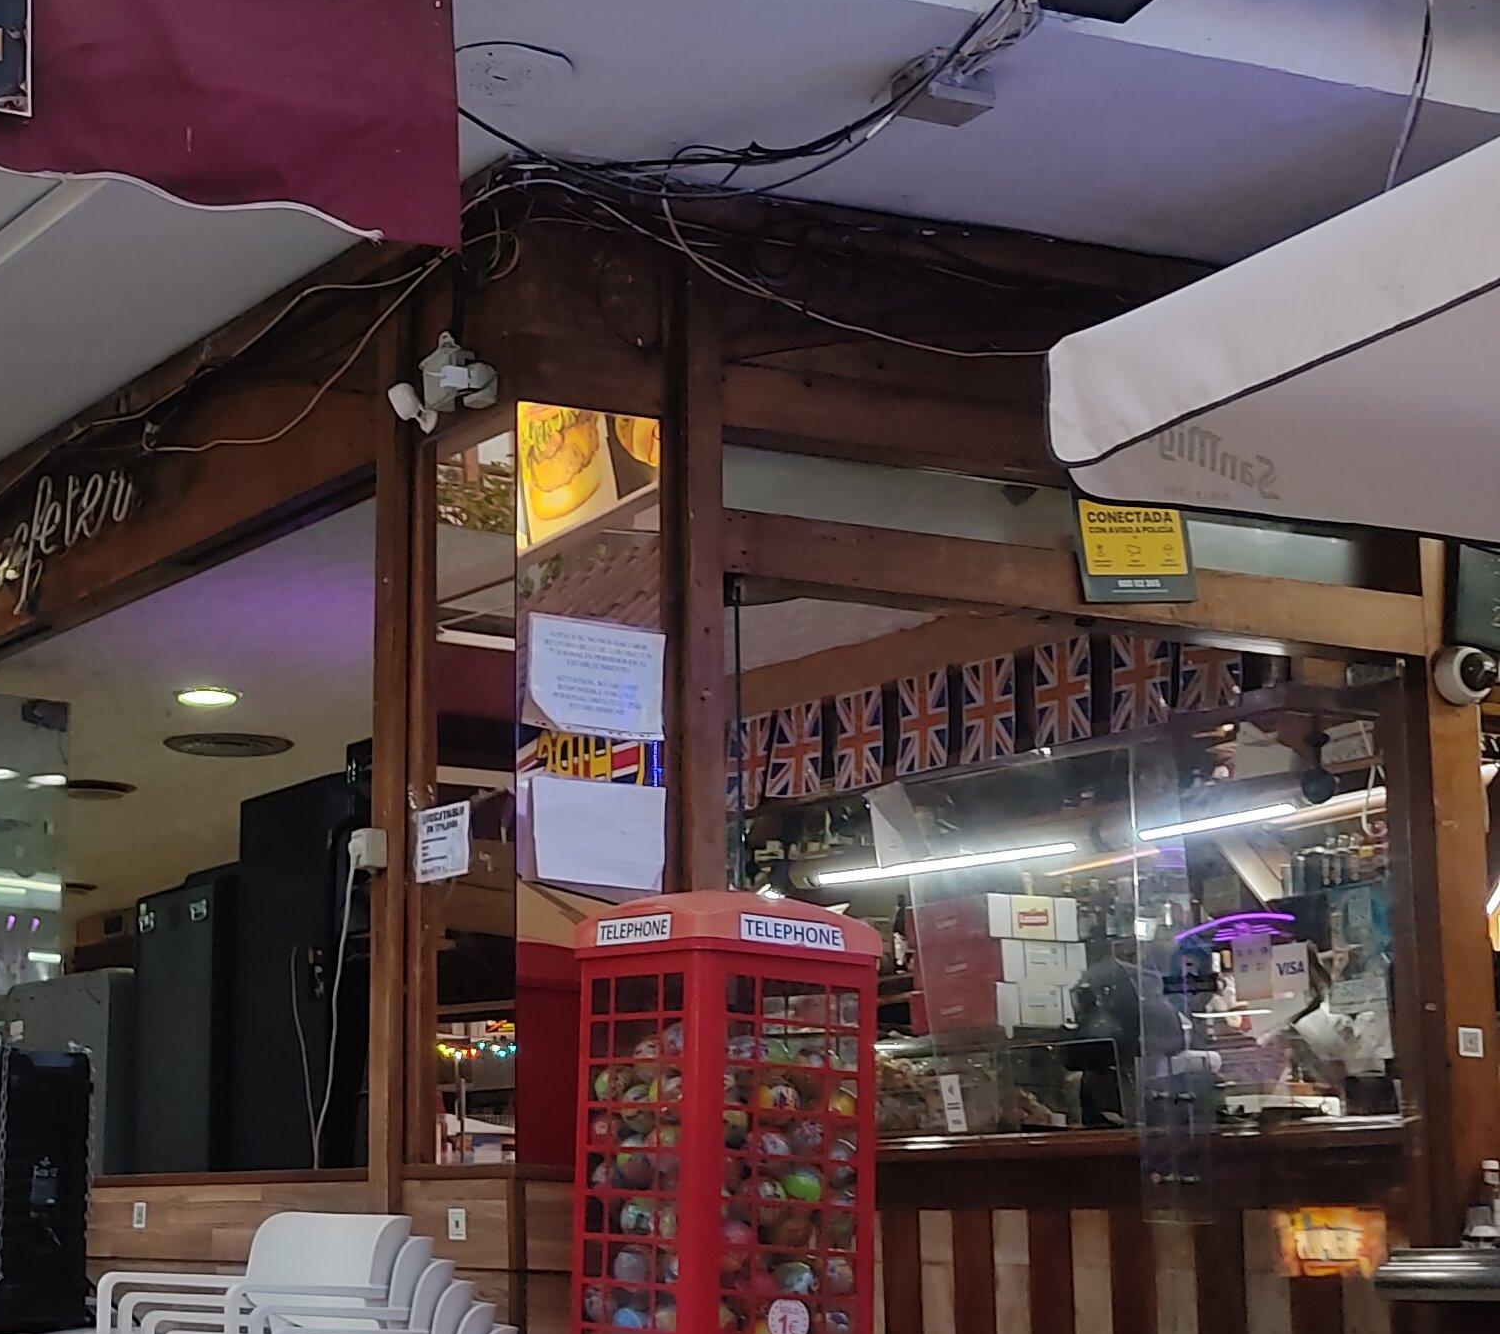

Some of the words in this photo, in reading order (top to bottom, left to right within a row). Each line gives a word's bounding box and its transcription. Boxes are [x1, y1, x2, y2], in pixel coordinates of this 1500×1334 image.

[1087, 511, 1173, 524] CONECTADA
[600, 917, 668, 941] TELEPHONE
[744, 918, 842, 947] TELEPHONE
[1276, 961, 1305, 976] VISA
